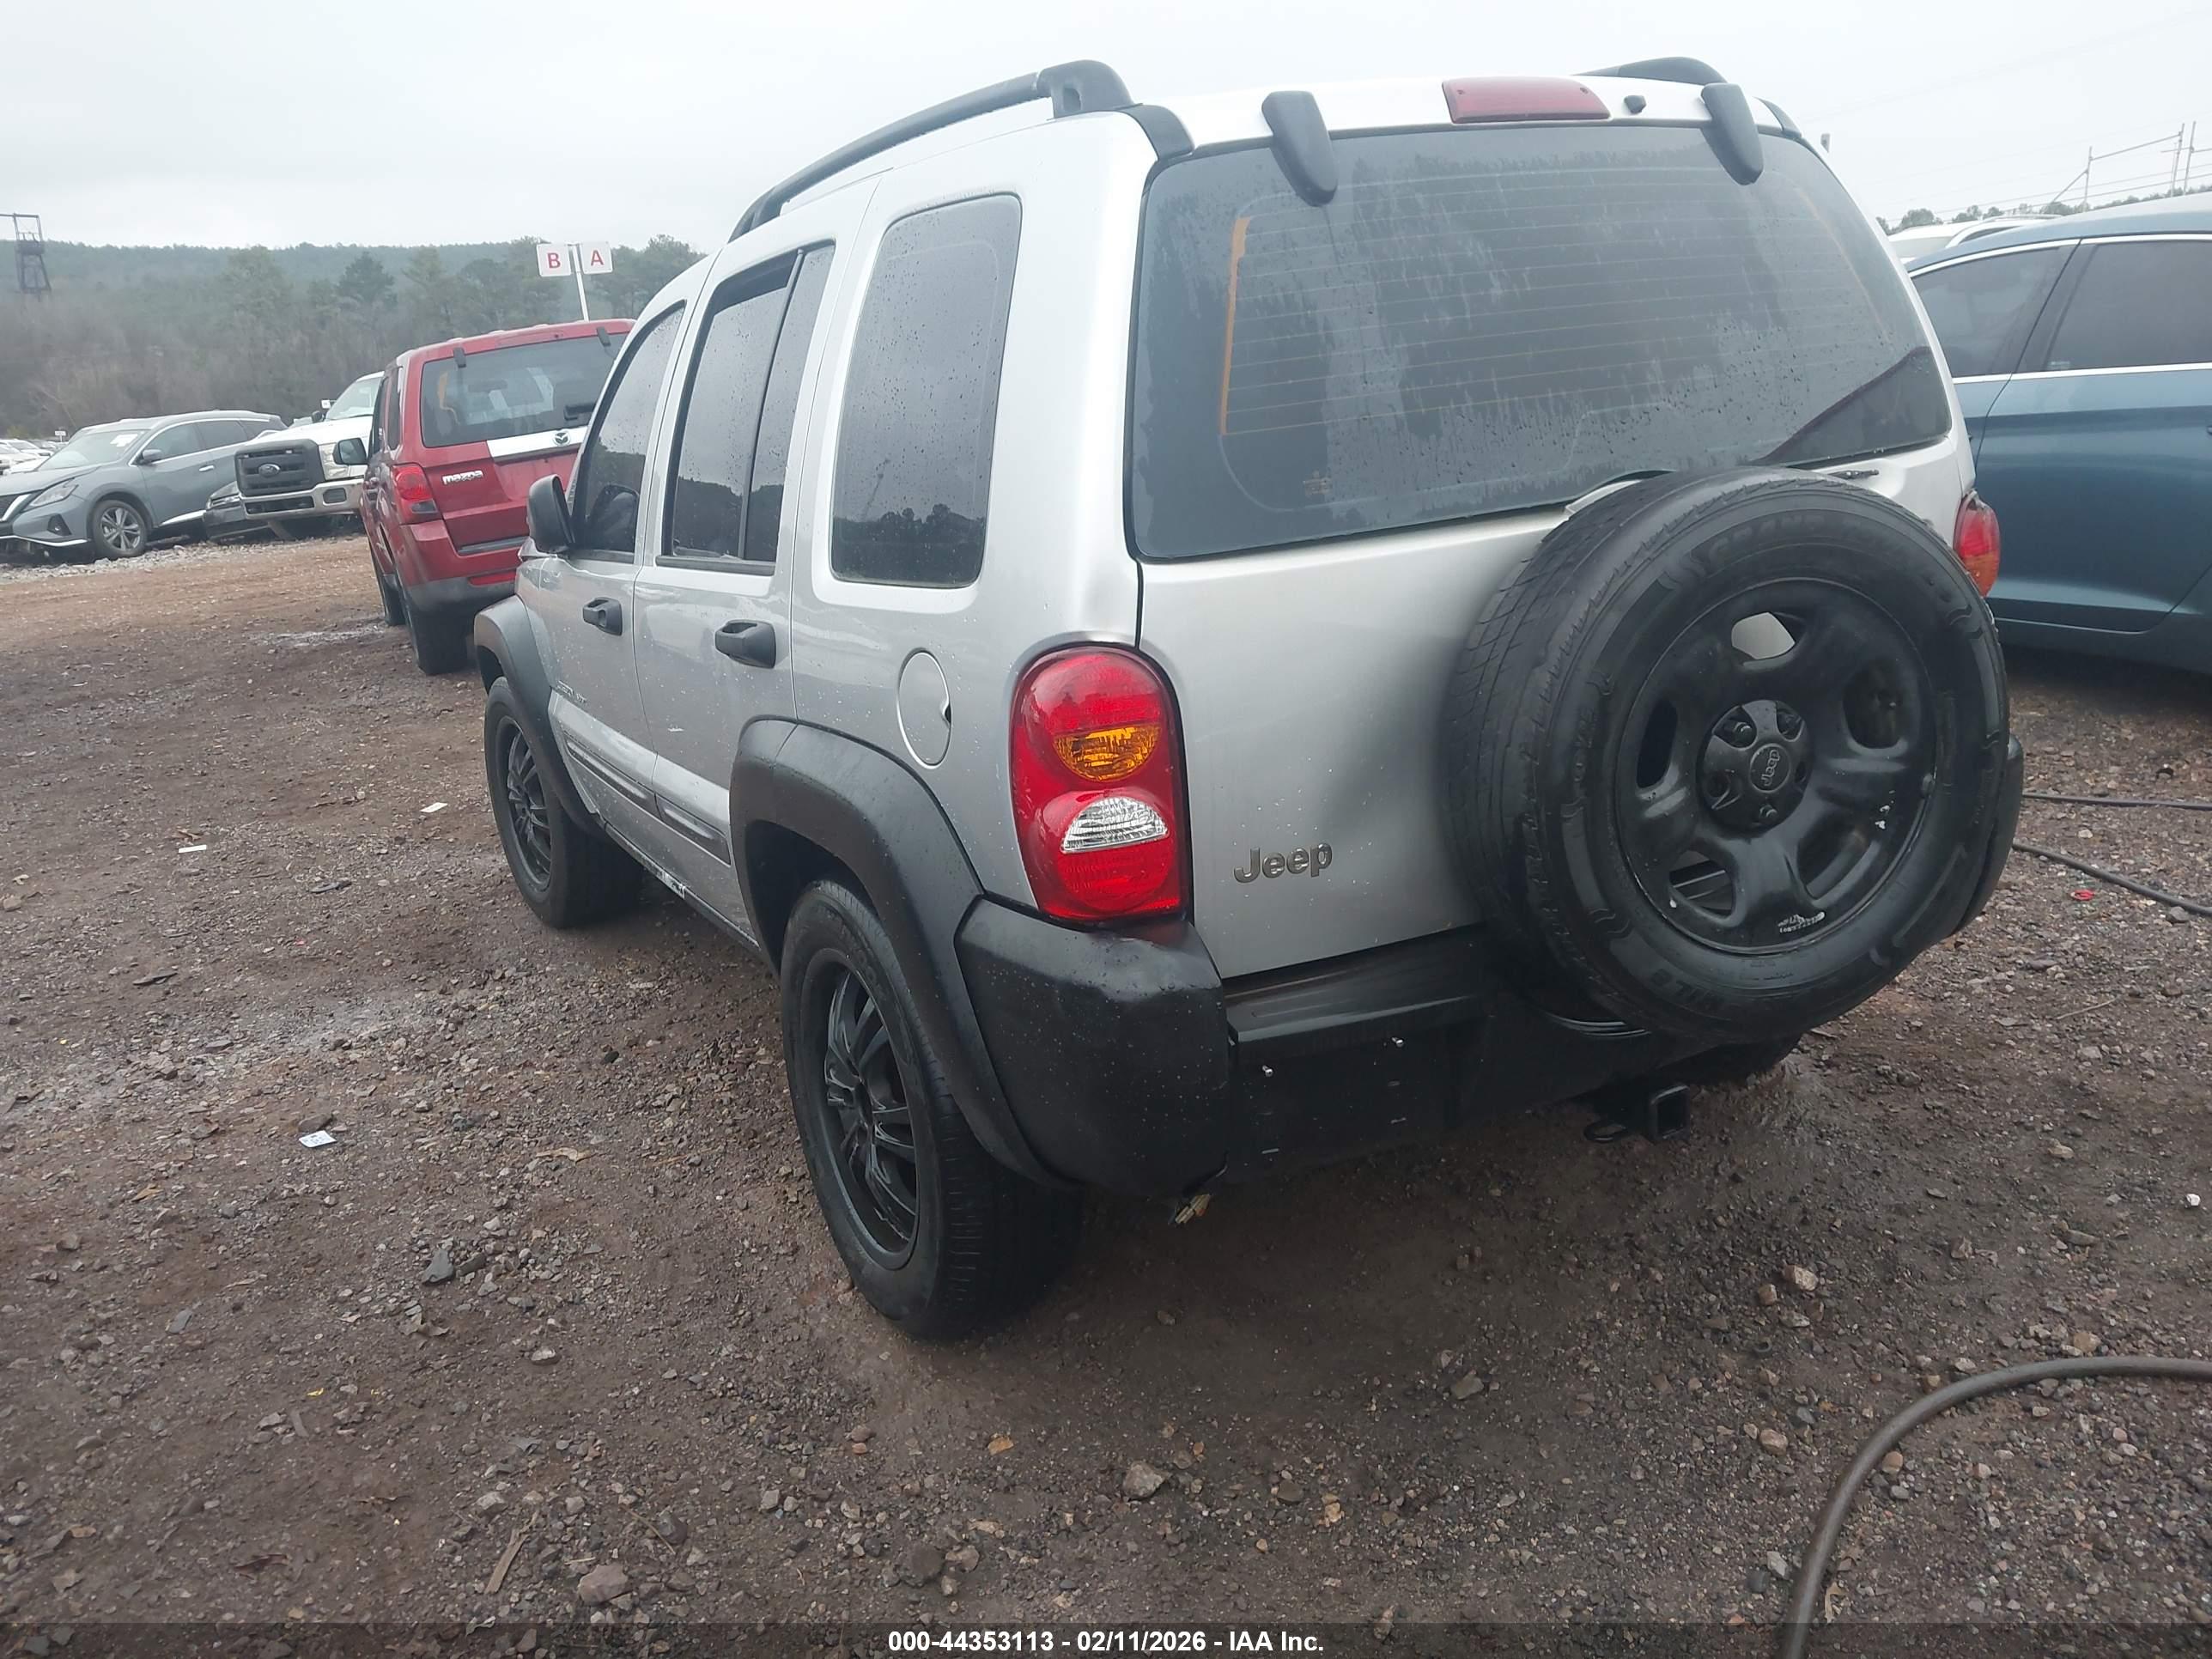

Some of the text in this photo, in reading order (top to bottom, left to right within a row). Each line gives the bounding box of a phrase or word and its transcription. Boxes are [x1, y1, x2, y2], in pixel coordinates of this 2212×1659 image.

[547, 252, 561, 269] B
[590, 250, 605, 266] A
[1760, 749, 1781, 787] Jeep
[1234, 842, 1333, 884] Jeep
